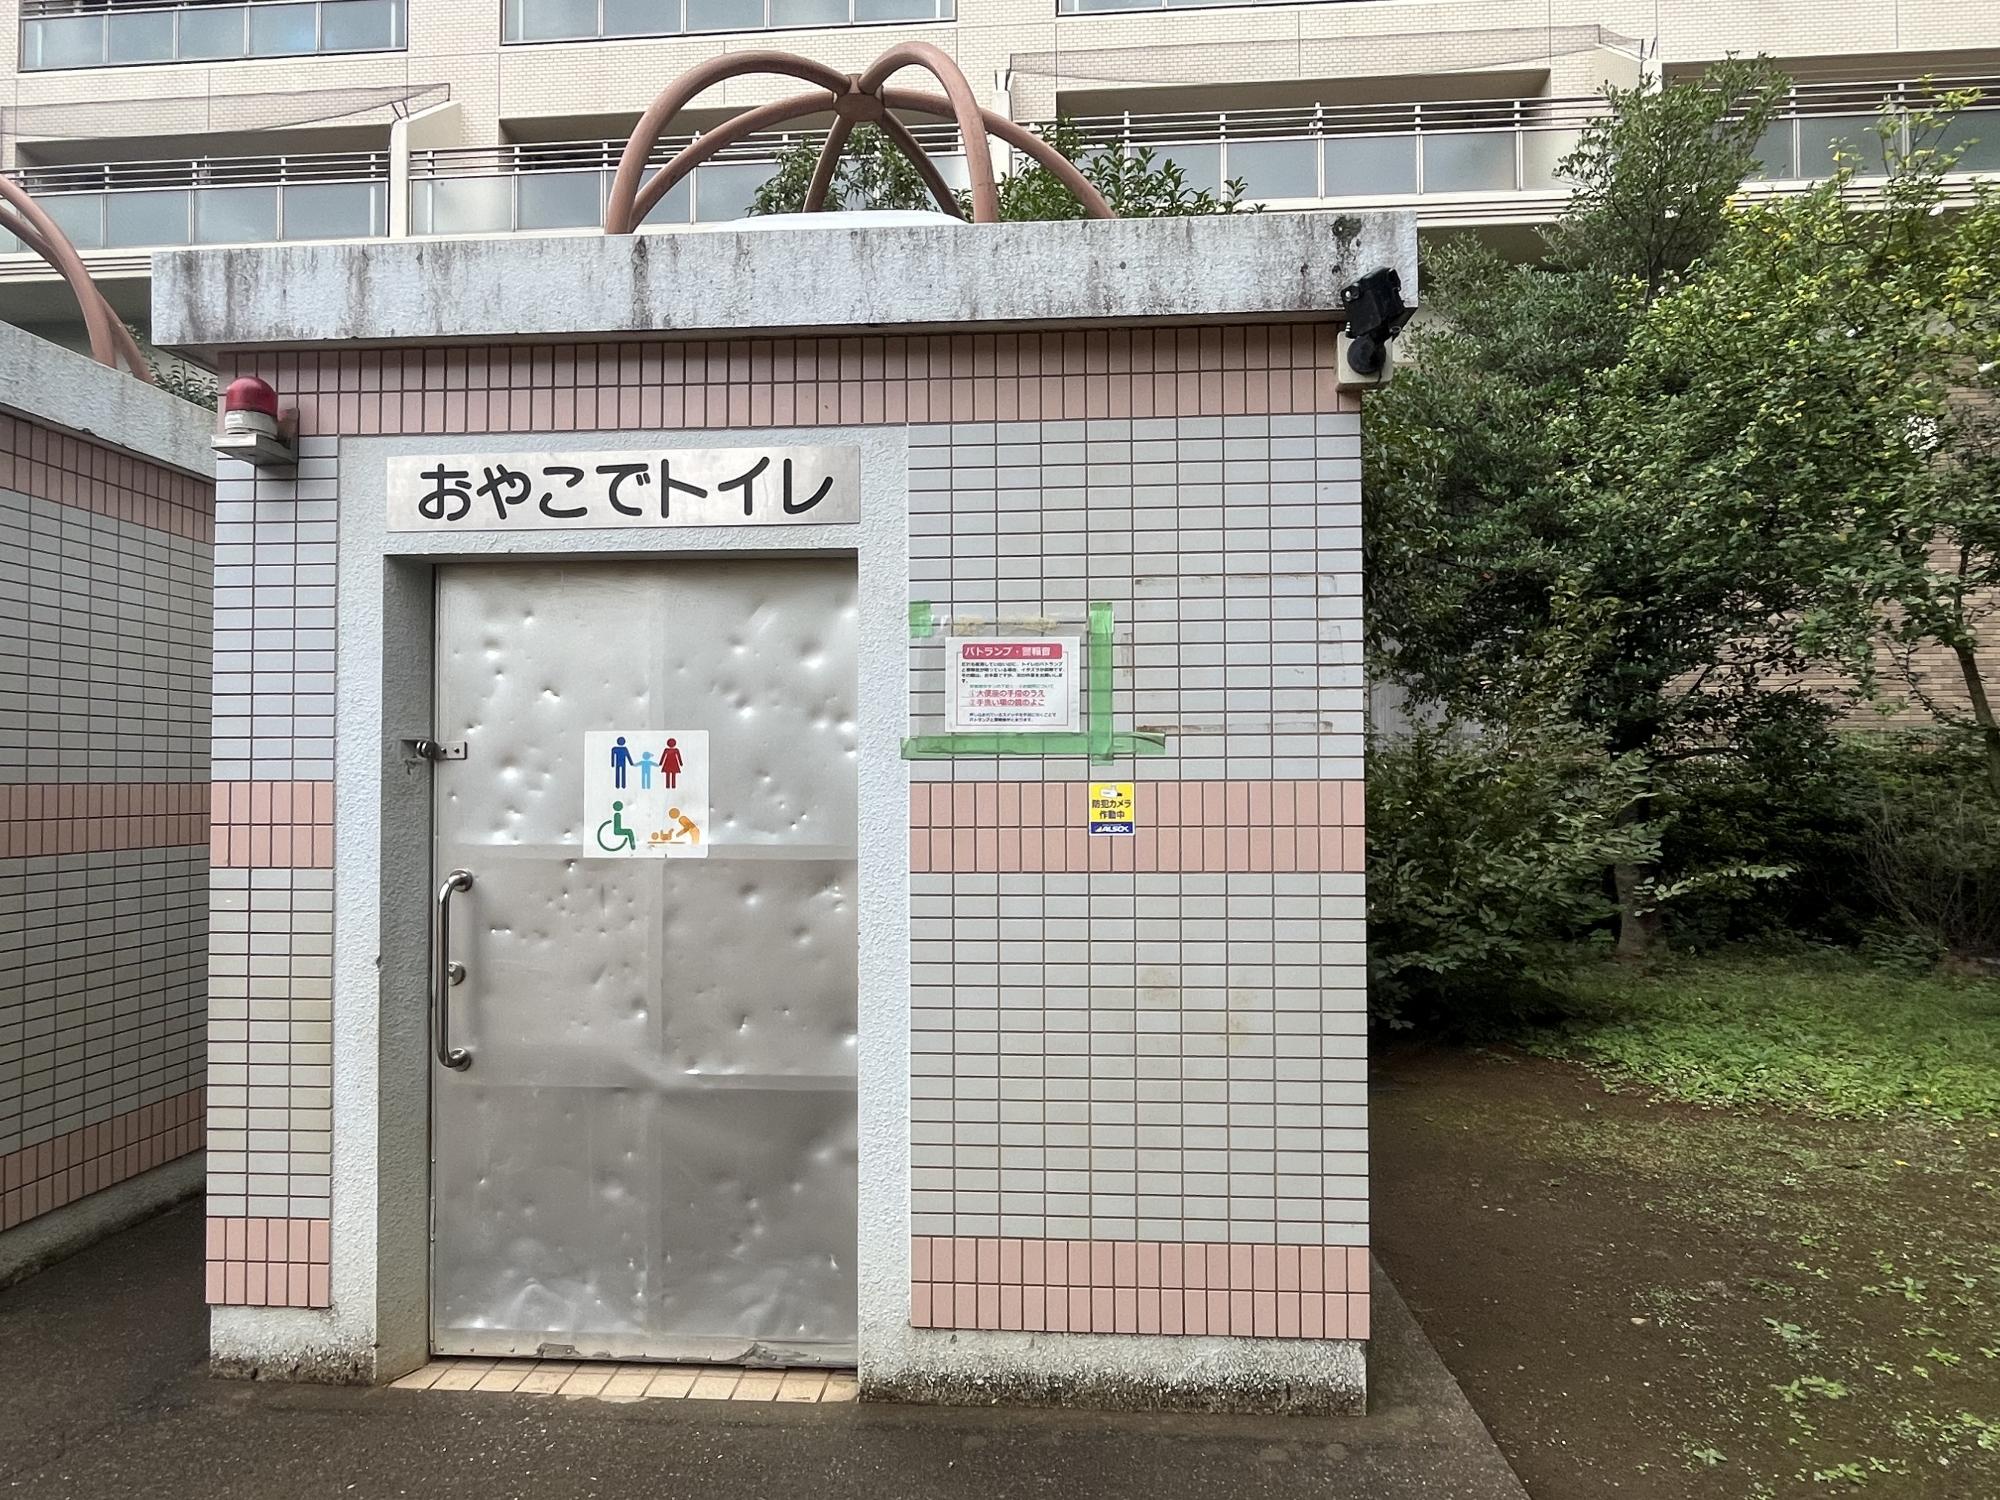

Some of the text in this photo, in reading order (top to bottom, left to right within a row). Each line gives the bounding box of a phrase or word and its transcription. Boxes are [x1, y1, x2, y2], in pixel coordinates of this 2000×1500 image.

[418, 456, 834, 521] おやこでトイレ
[1092, 799, 1132, 809] 防犯カメラ
[1099, 810, 1125, 820] 作動中
